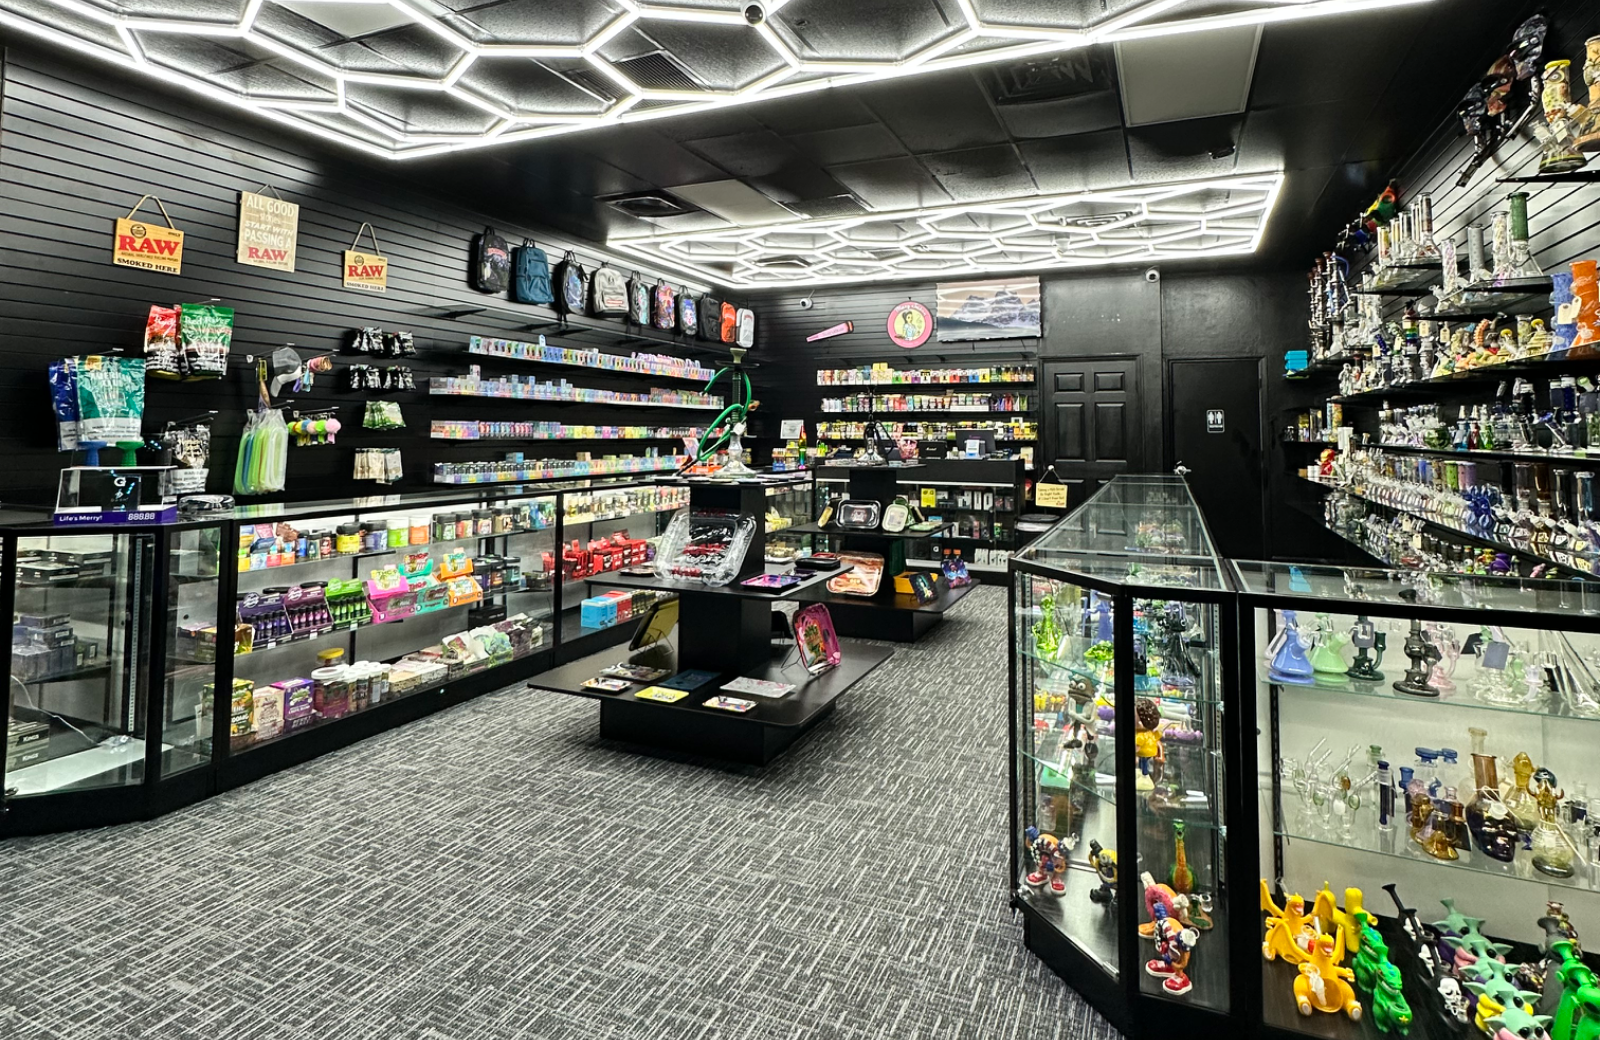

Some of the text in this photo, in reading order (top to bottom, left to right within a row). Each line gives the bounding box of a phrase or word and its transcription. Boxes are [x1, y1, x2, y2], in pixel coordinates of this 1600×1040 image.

[246, 195, 294, 217] ALL GOOD
[245, 220, 294, 236] START WITH
[118, 234, 180, 256] RAW
[244, 228, 292, 249] PASSING A
[247, 246, 288, 261] RAW
[117, 258, 178, 273] SMOKED HERE
[347, 264, 384, 277] RAW
